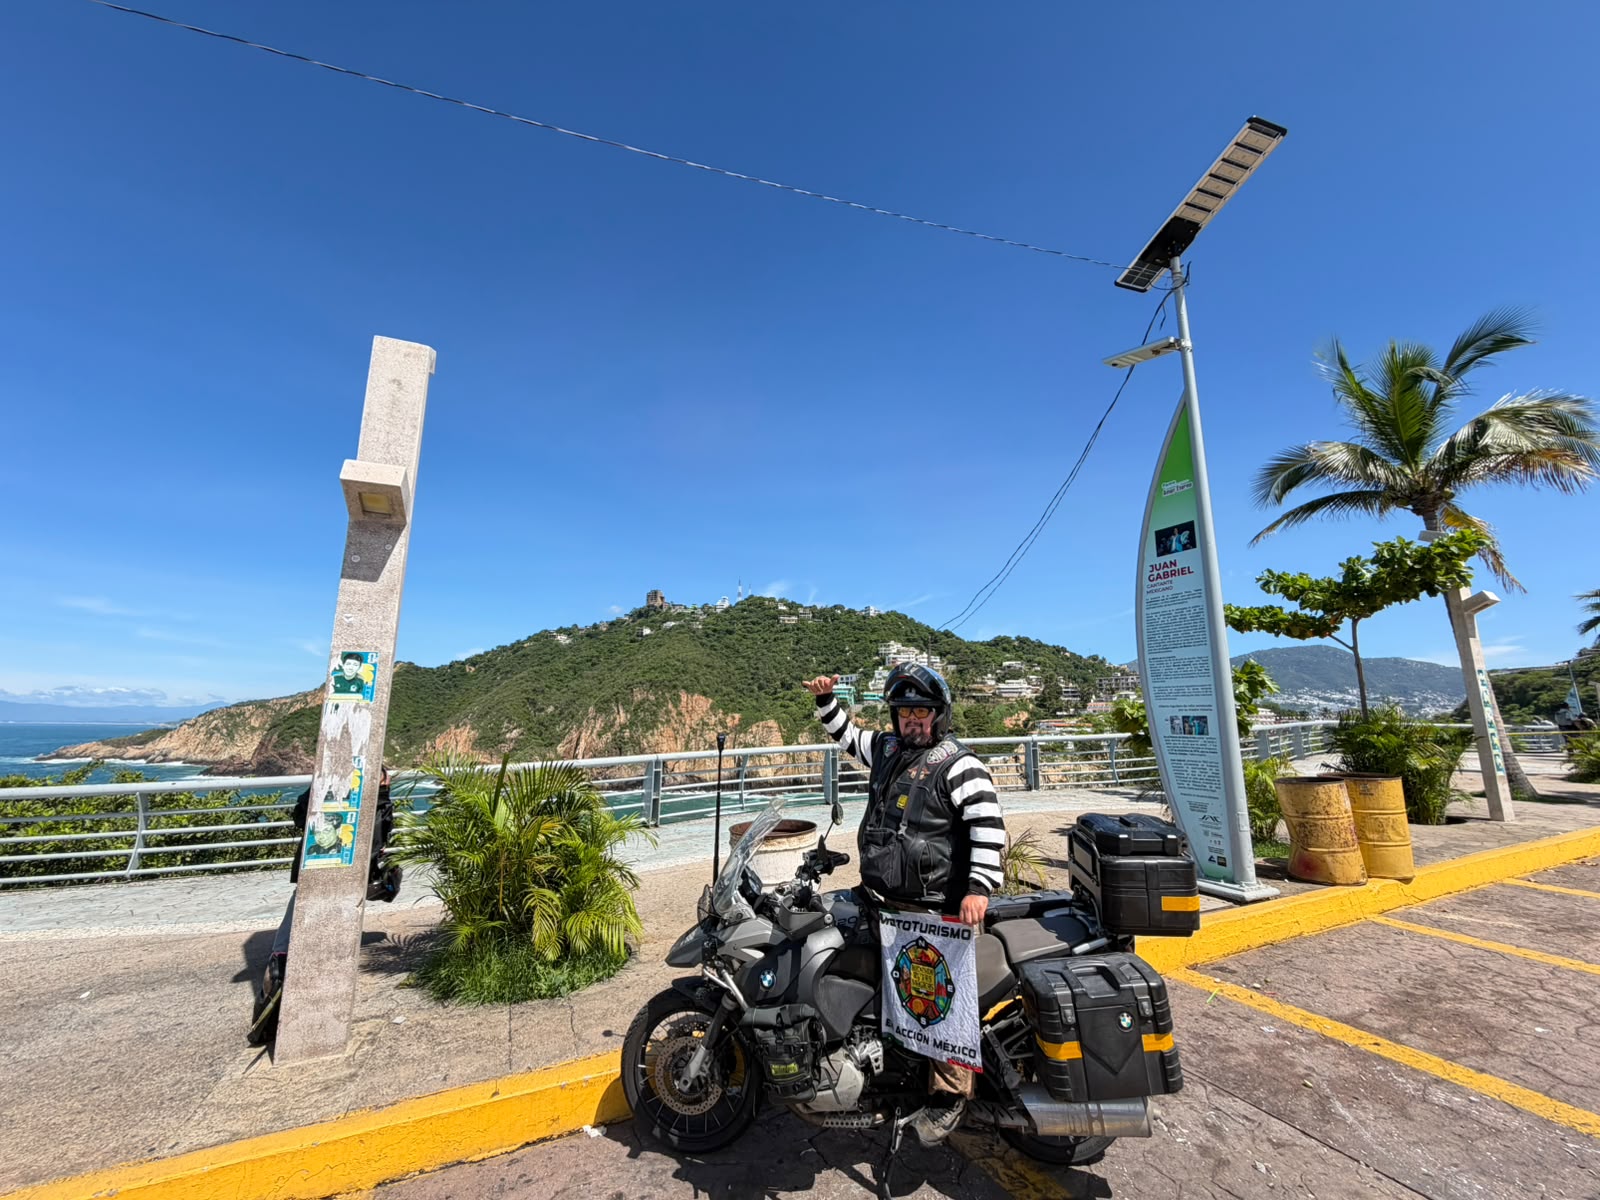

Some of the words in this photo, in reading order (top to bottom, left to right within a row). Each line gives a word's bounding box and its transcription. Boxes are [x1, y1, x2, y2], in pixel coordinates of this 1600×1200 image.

[1149, 559, 1177, 573] JUAN
[1147, 566, 1194, 582] GABRIEL
[1146, 579, 1173, 589] CANTANTE
[1146, 585, 1174, 595] MEXICANO
[895, 1028, 930, 1045] ACCIÓN
[933, 1039, 977, 1059] MÉXICO
